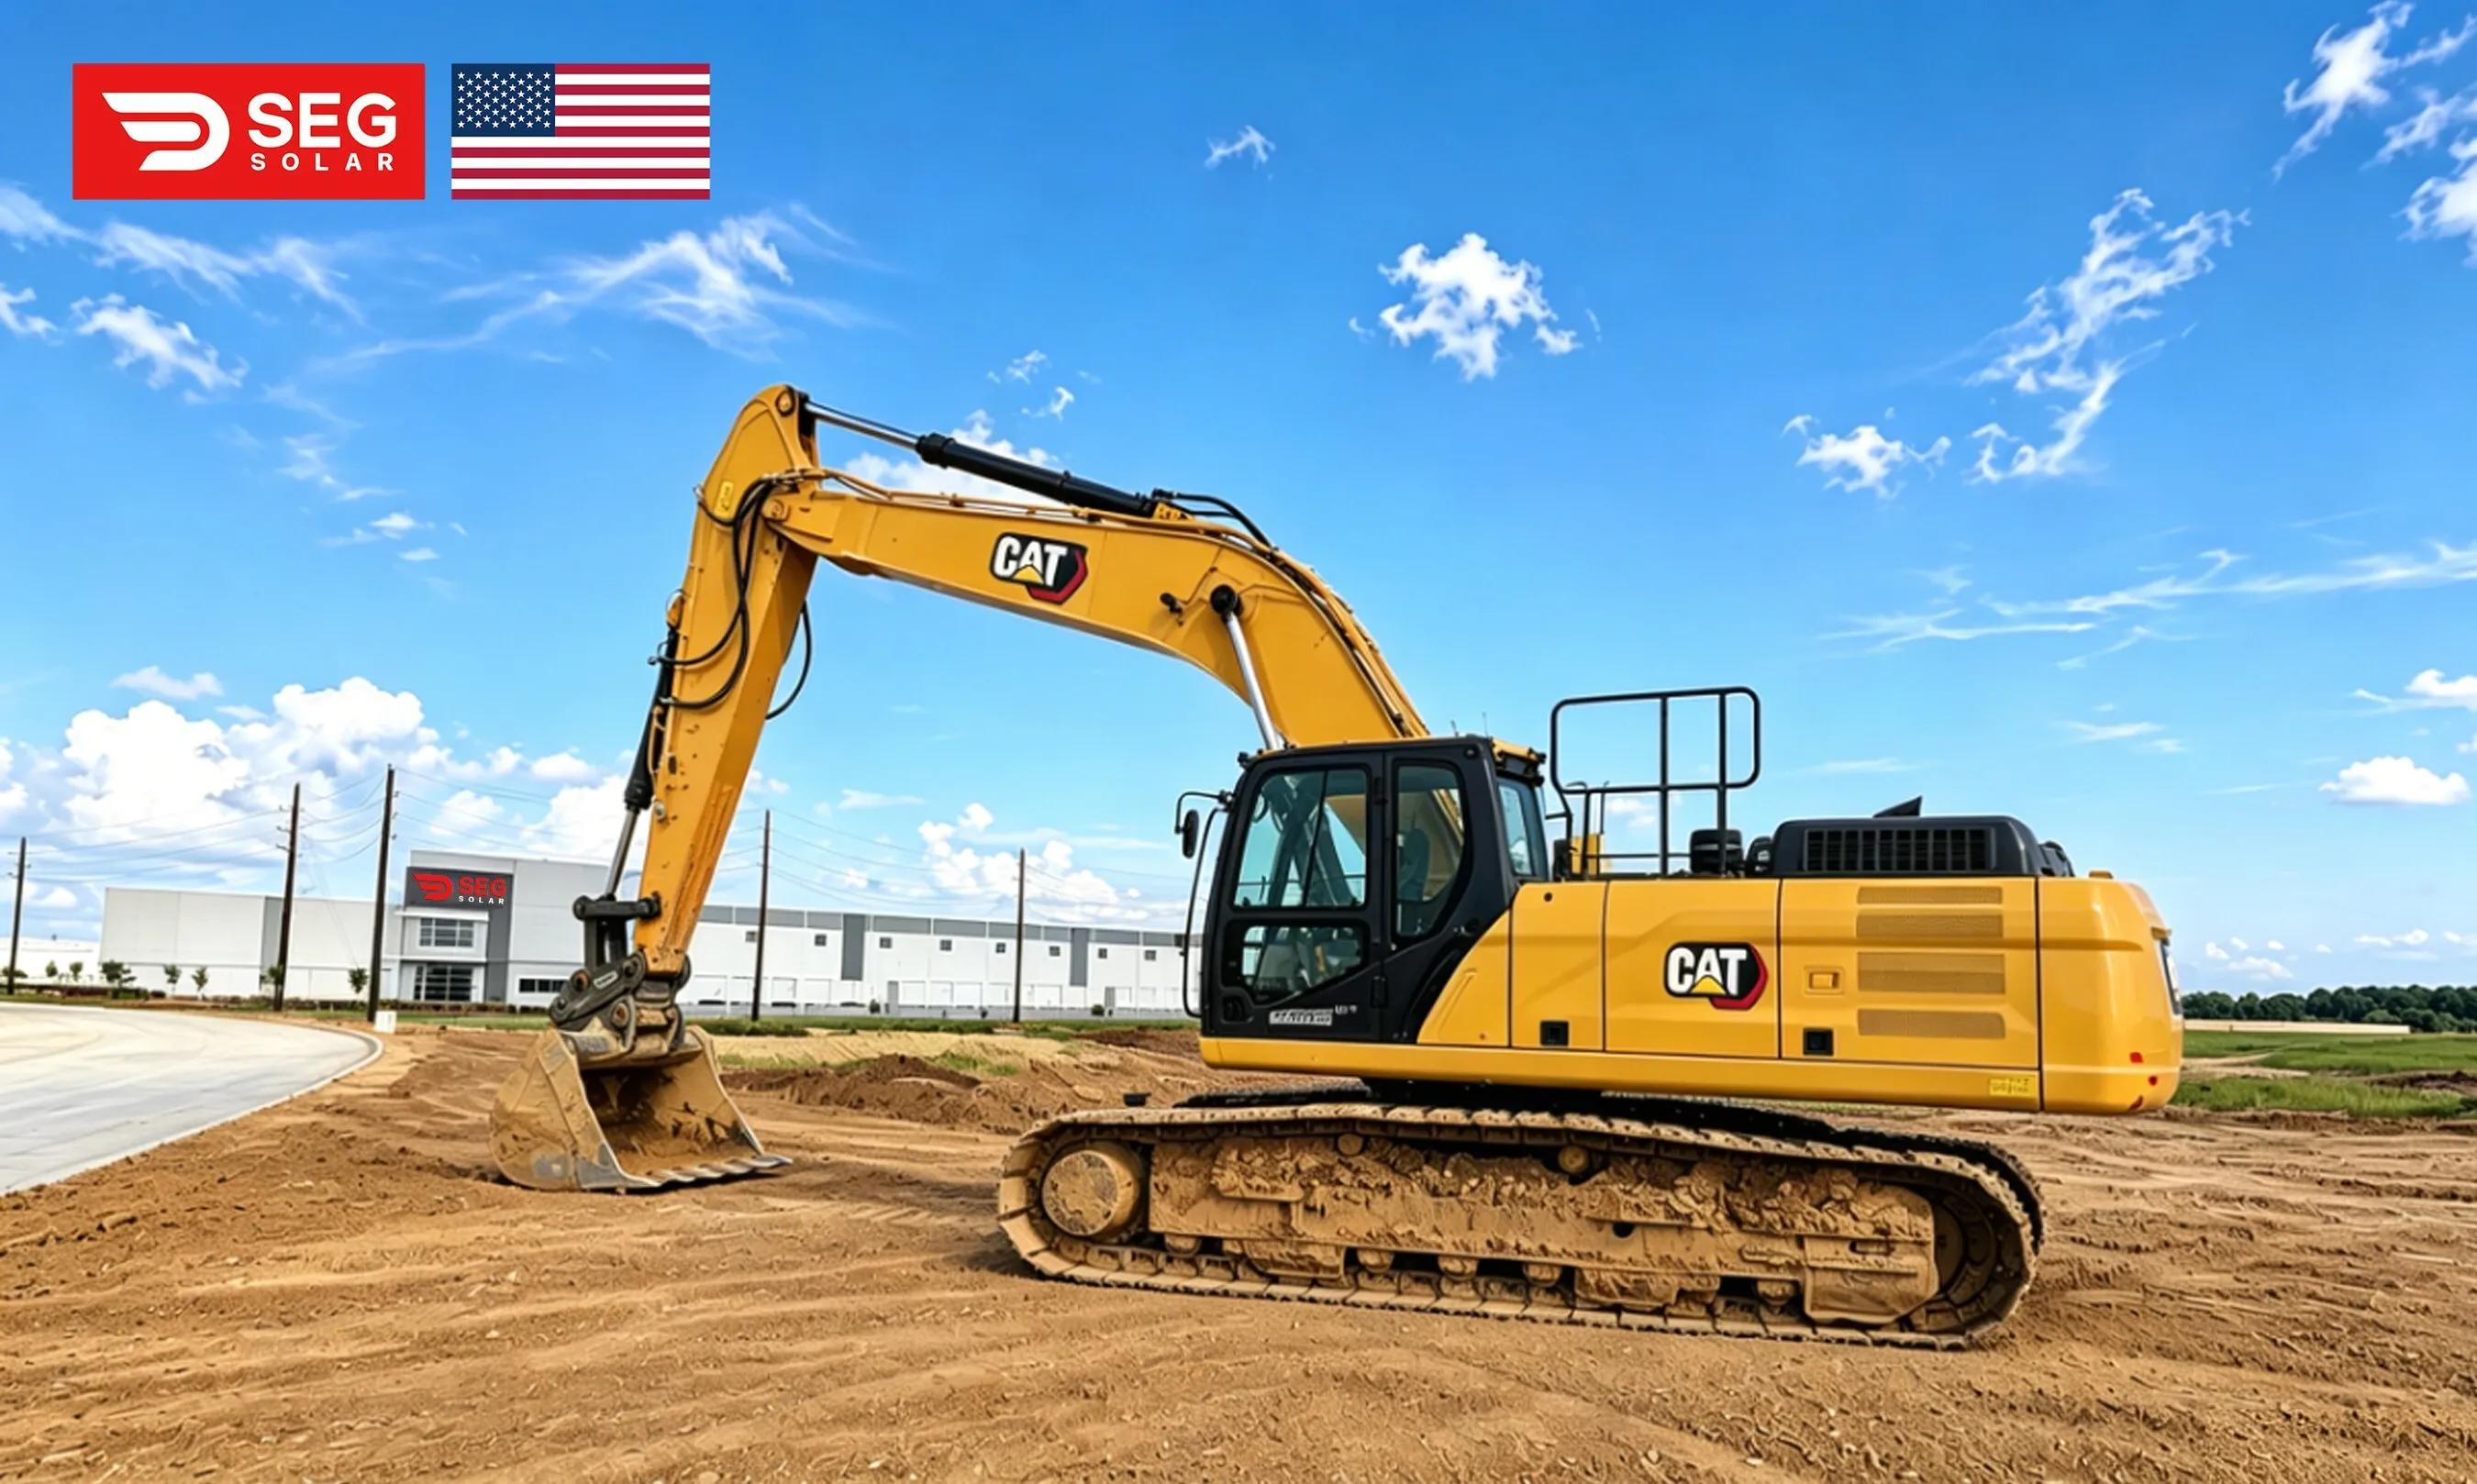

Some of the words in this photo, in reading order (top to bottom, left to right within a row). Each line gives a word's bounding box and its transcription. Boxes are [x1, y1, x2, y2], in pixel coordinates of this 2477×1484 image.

[994, 535, 1068, 587] CAT
[458, 876, 506, 897] SEG
[458, 895, 505, 905] SOLAR
[1667, 947, 1747, 997] CAT
